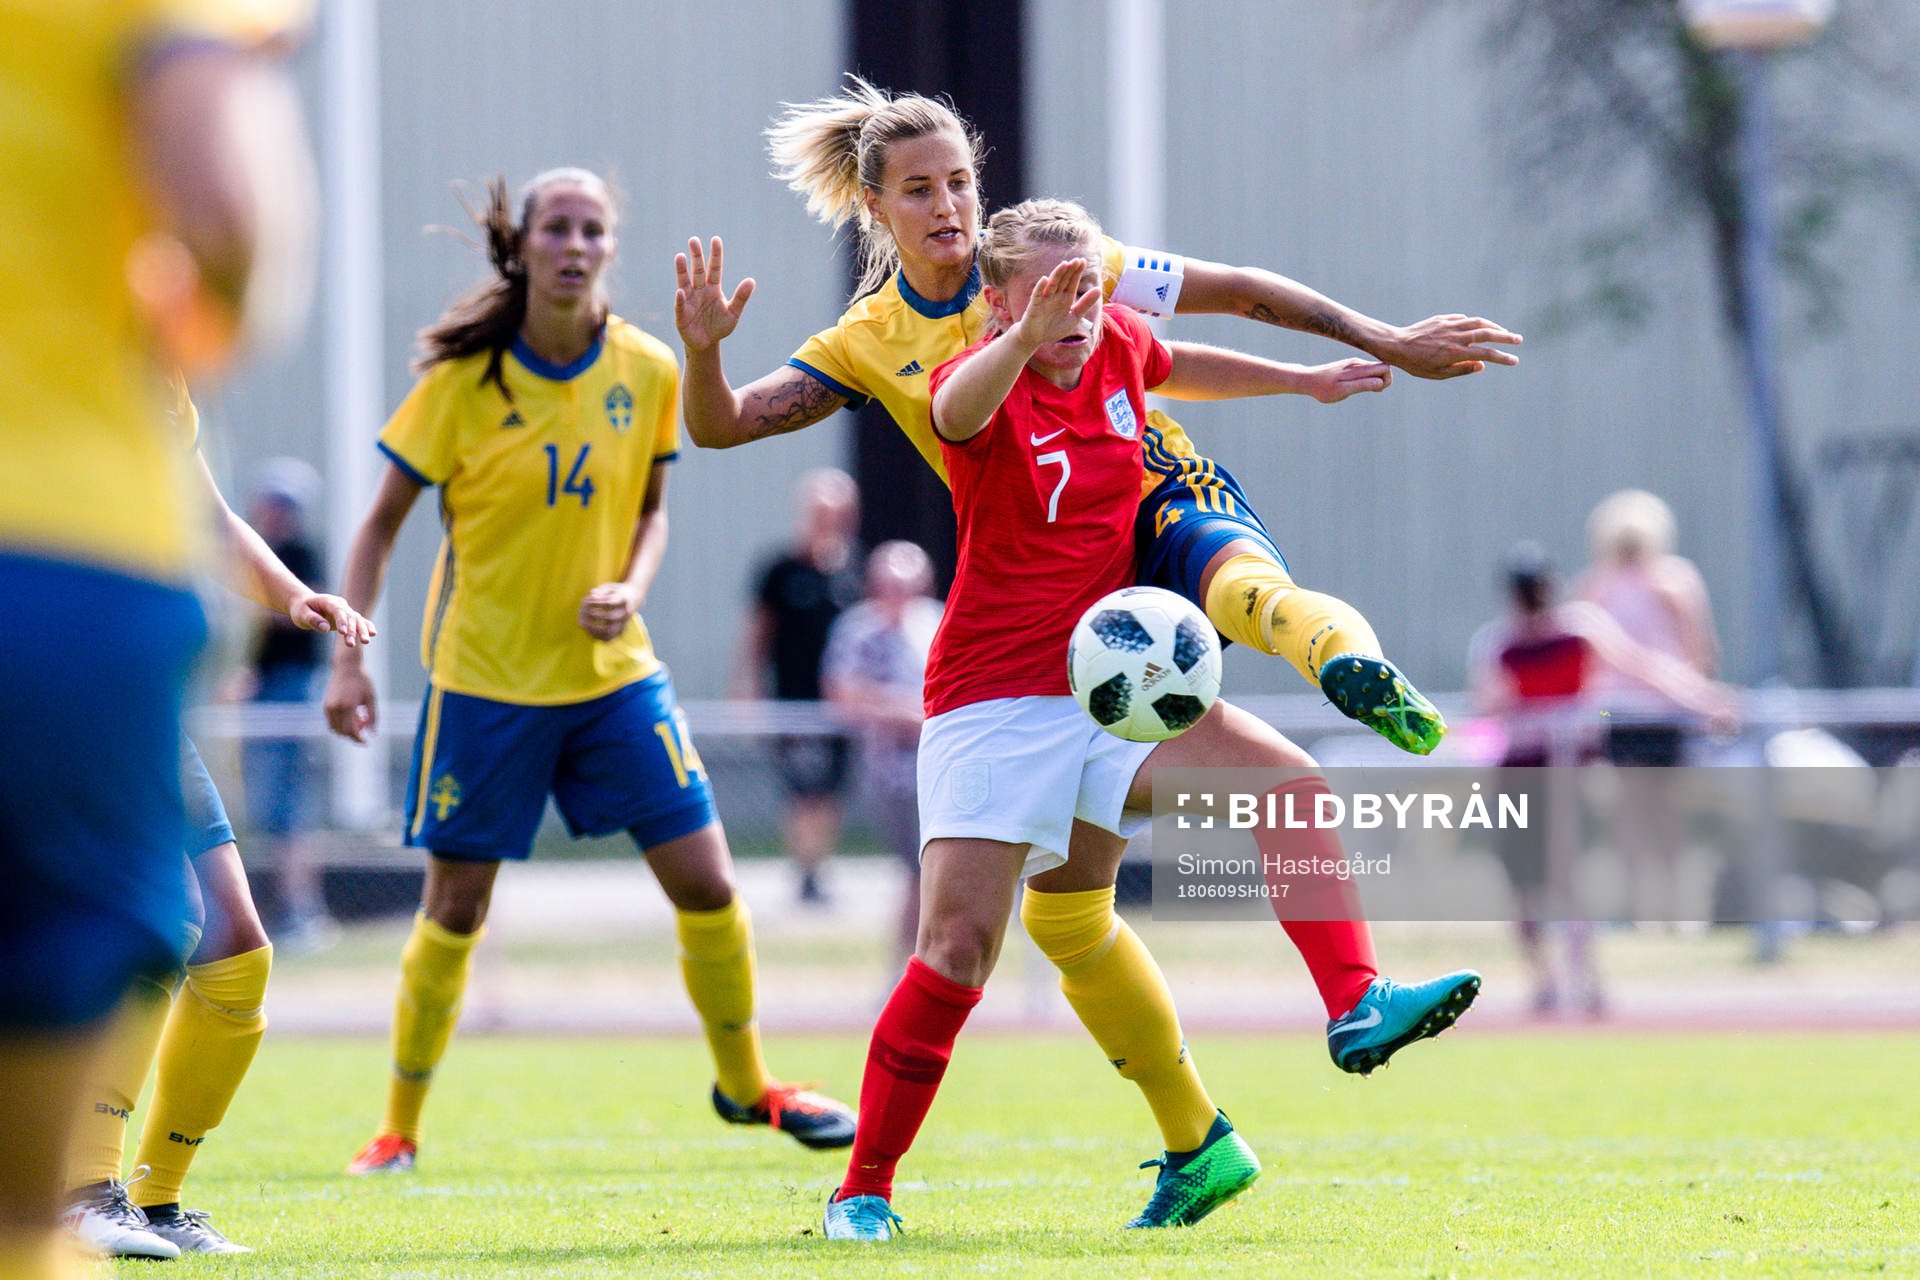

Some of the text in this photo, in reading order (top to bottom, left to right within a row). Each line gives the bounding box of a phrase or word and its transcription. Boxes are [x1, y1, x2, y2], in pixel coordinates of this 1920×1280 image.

[545, 444, 595, 507] 14
[1037, 450, 1071, 523] 7
[1155, 499, 1185, 538] 4
